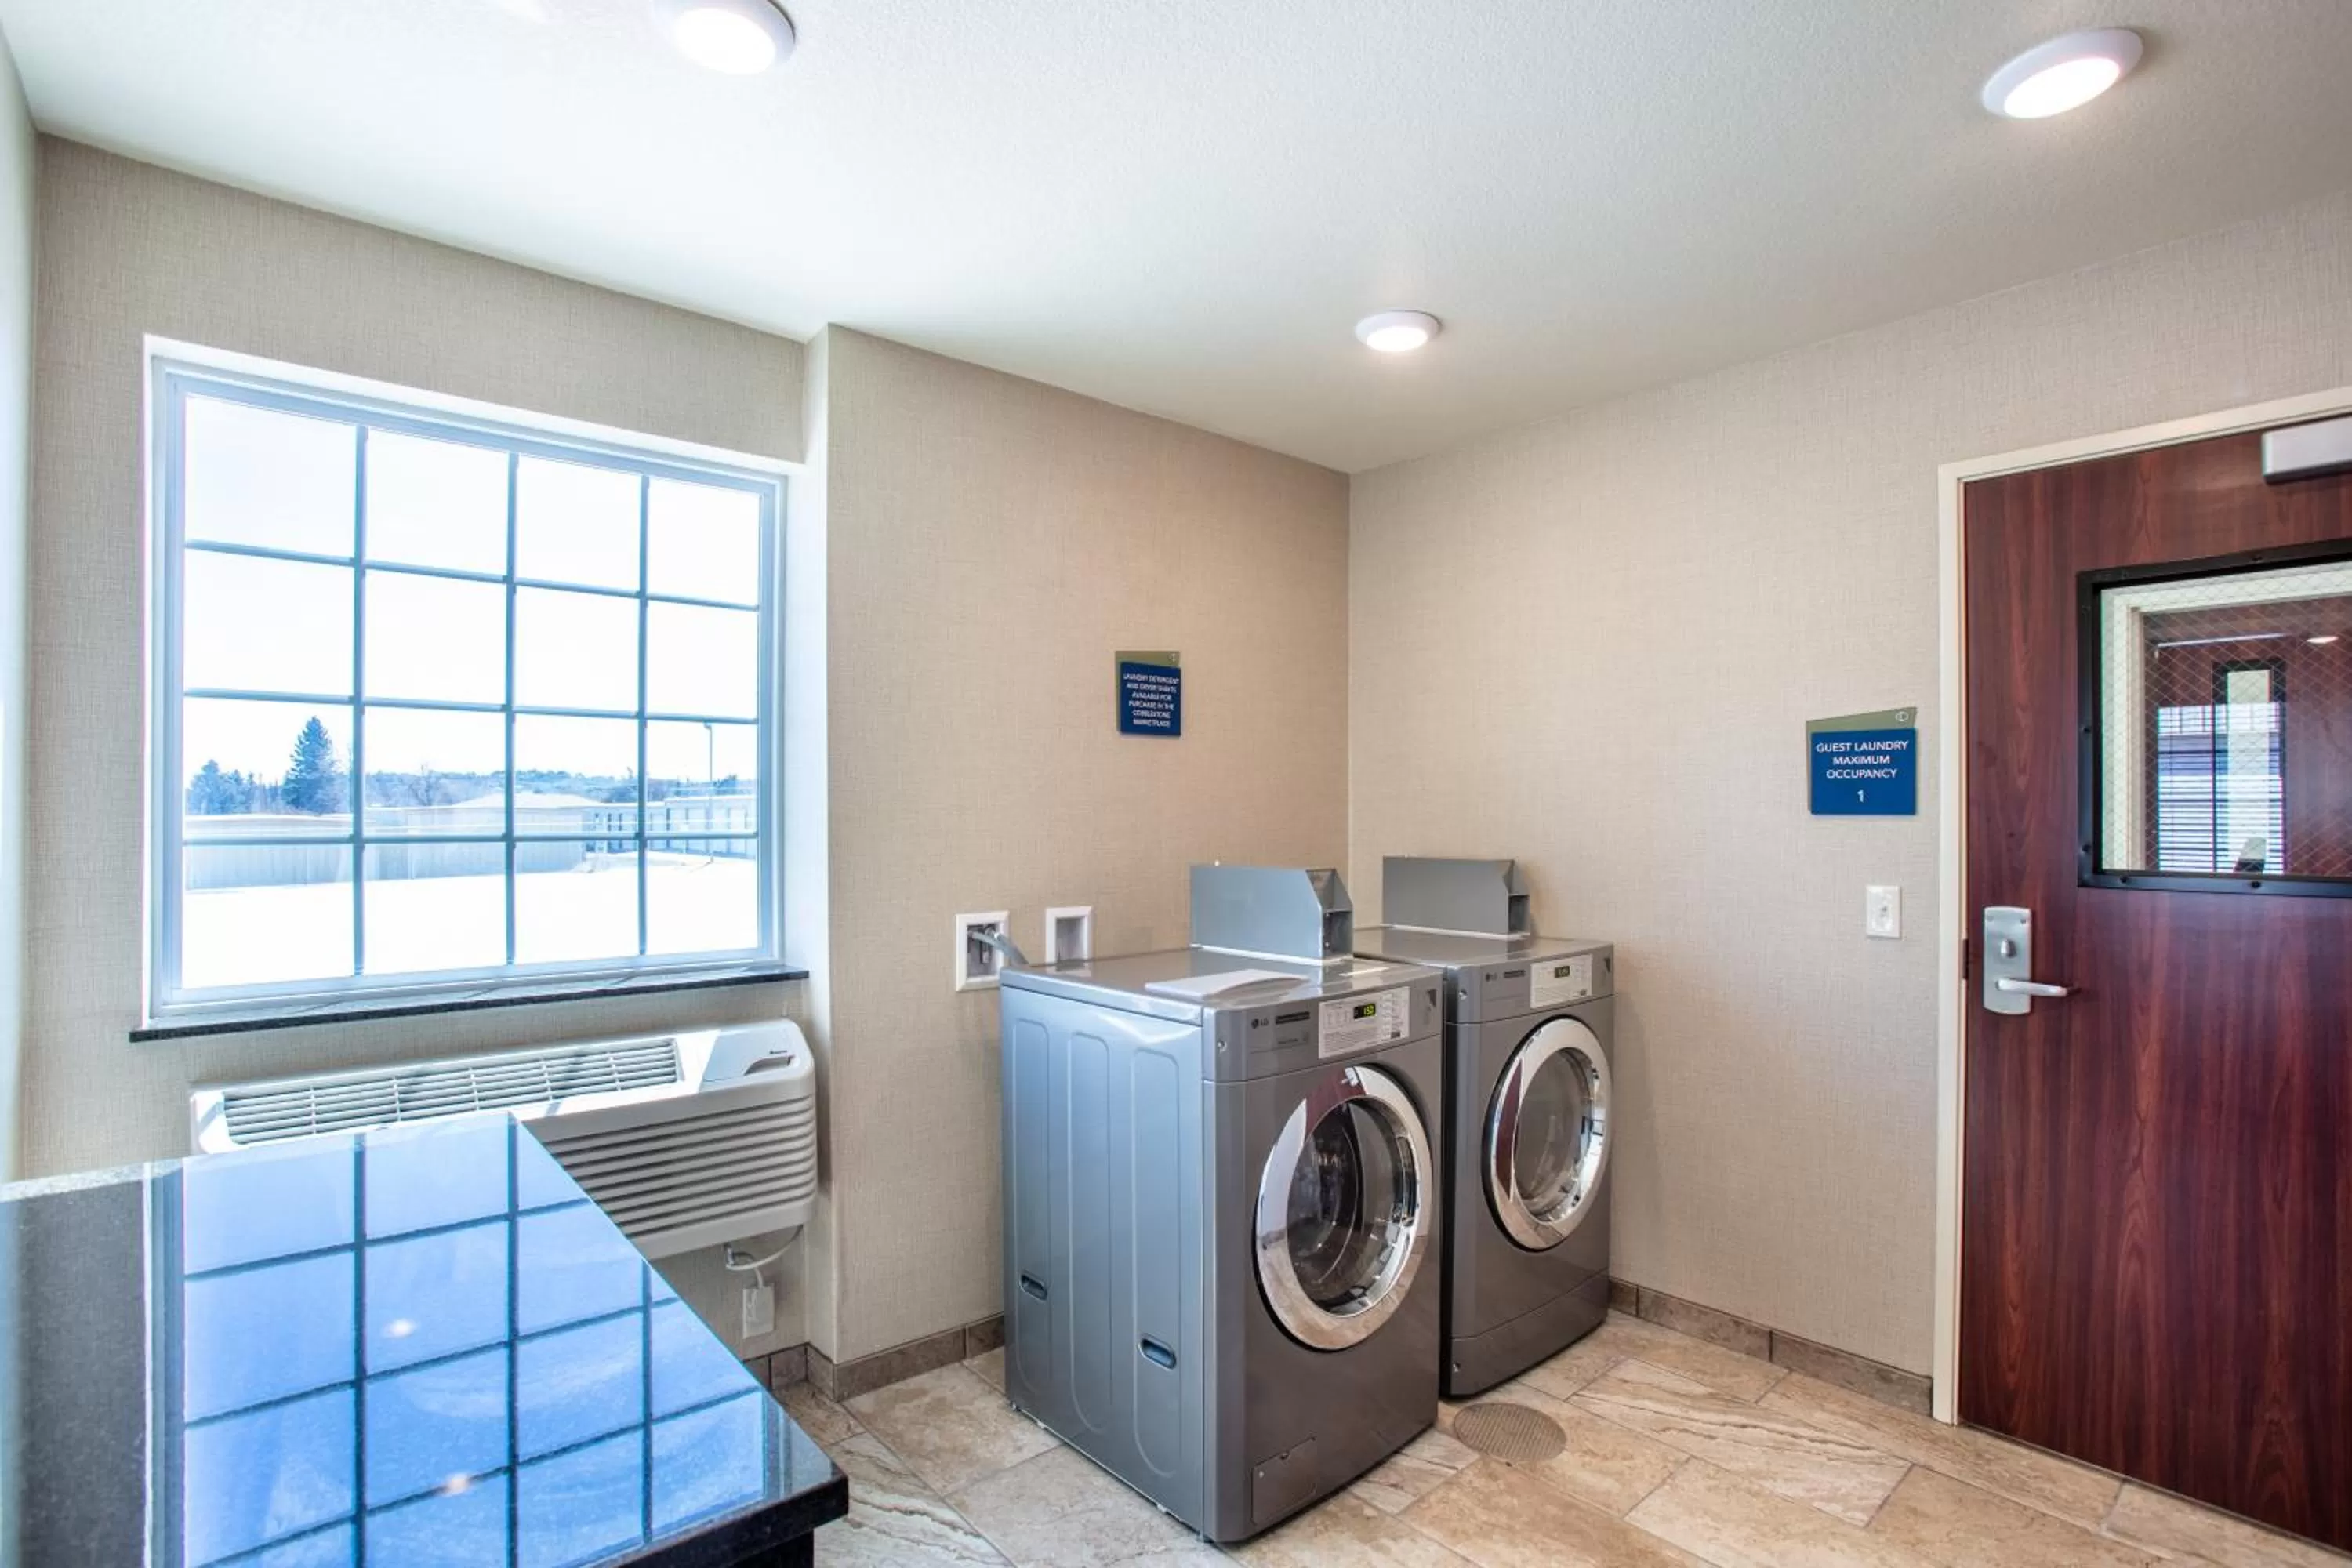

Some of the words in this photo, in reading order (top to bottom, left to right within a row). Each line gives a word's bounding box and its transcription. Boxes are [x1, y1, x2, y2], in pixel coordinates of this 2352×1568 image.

[1123, 673, 1148, 681] LAUNDRY
[1816, 742, 1852, 753] GUEST
[1854, 740, 1909, 751] LAUNDRY
[1833, 755, 1890, 765] MAXIMUM
[1826, 768, 1897, 779] OCCUPANCY
[1857, 789, 1864, 803] 1
